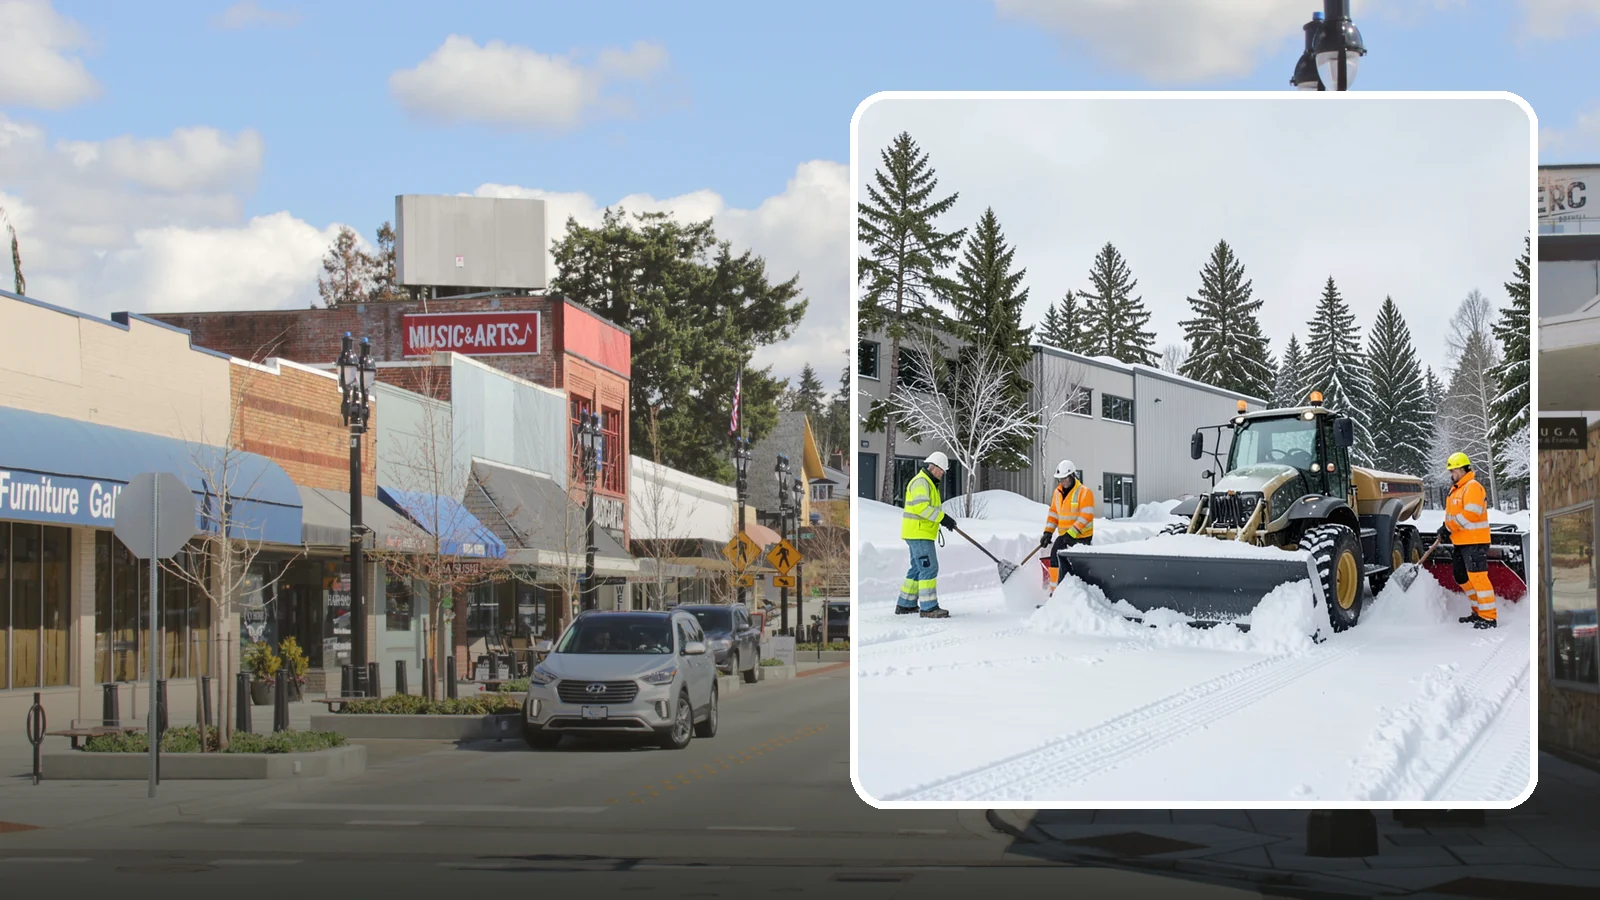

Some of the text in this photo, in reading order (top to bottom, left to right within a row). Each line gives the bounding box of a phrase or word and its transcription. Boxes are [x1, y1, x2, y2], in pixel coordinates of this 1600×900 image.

[0, 471, 122, 519] Furniture Gal
[453, 563, 480, 574] SUSHI
